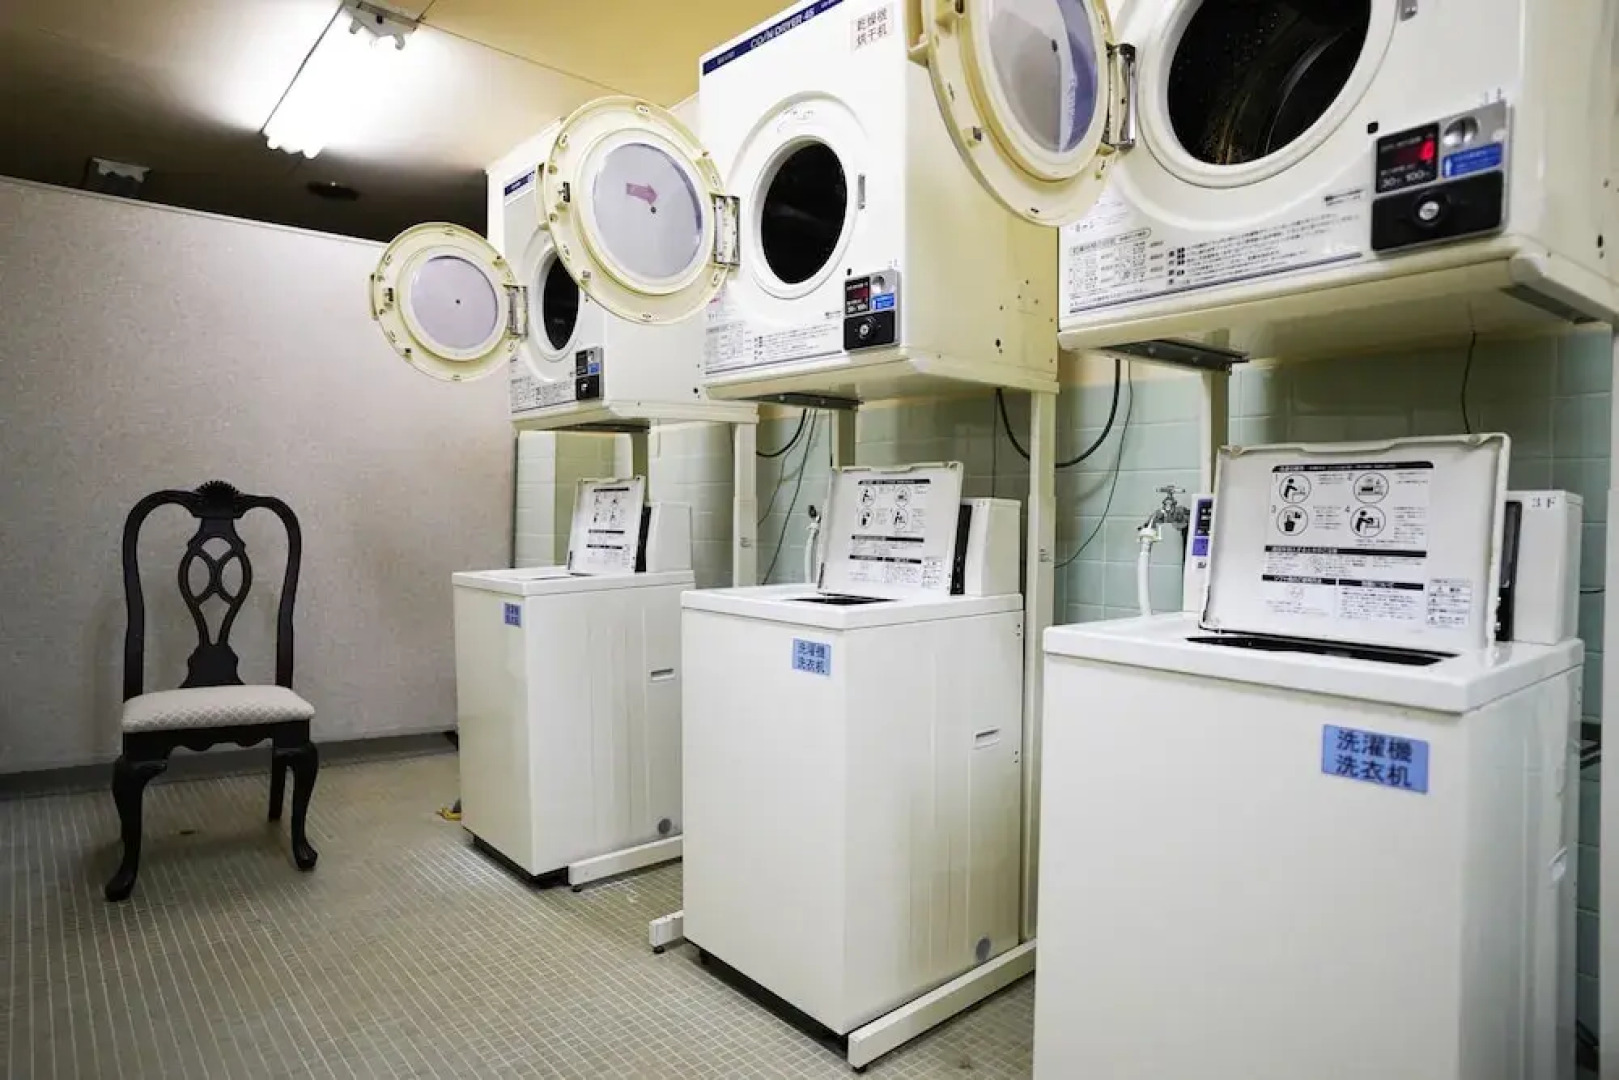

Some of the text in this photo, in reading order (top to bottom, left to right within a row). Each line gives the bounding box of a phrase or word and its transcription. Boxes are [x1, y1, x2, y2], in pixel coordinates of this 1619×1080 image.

[750, 28, 775, 50] COIN
[1336, 729, 1412, 763] 洗濯機
[1335, 755, 1412, 788] 洗衣机
